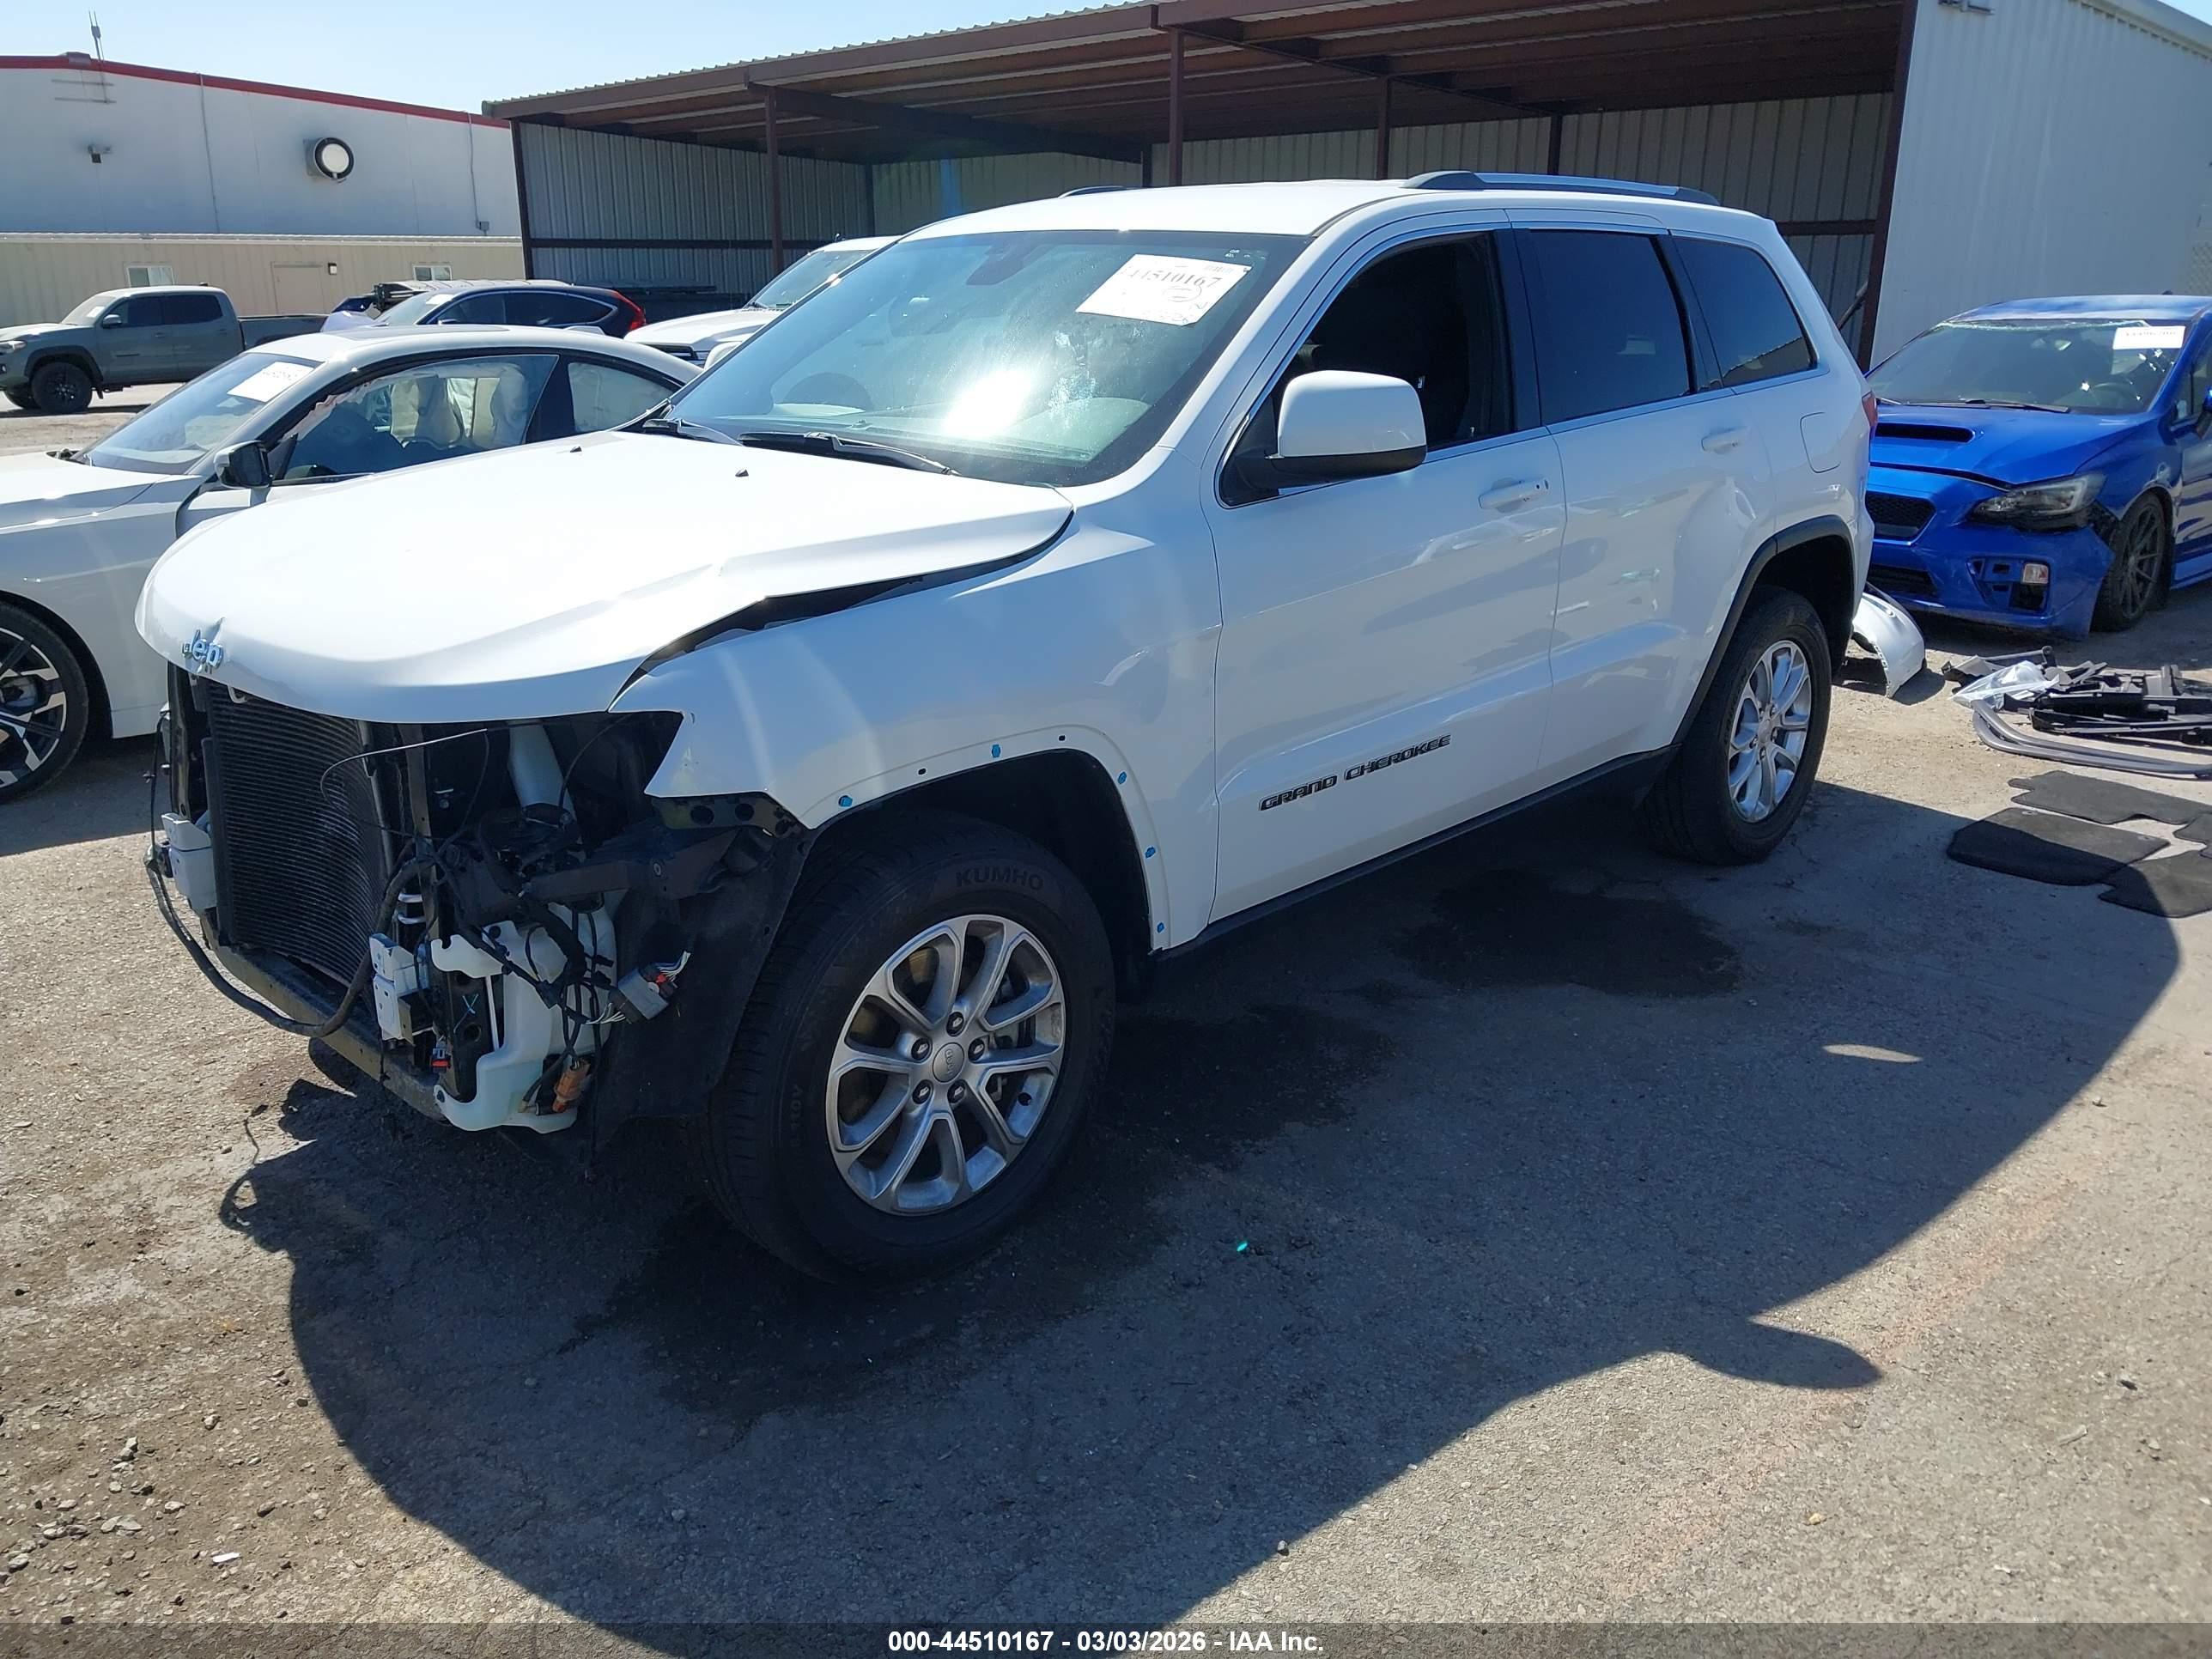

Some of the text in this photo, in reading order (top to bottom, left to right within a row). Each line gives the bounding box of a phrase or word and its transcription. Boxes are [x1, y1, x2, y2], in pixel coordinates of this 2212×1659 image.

[1259, 734, 1451, 811] GRAND CHEROKEE
[956, 865, 1044, 890] KUMHO
